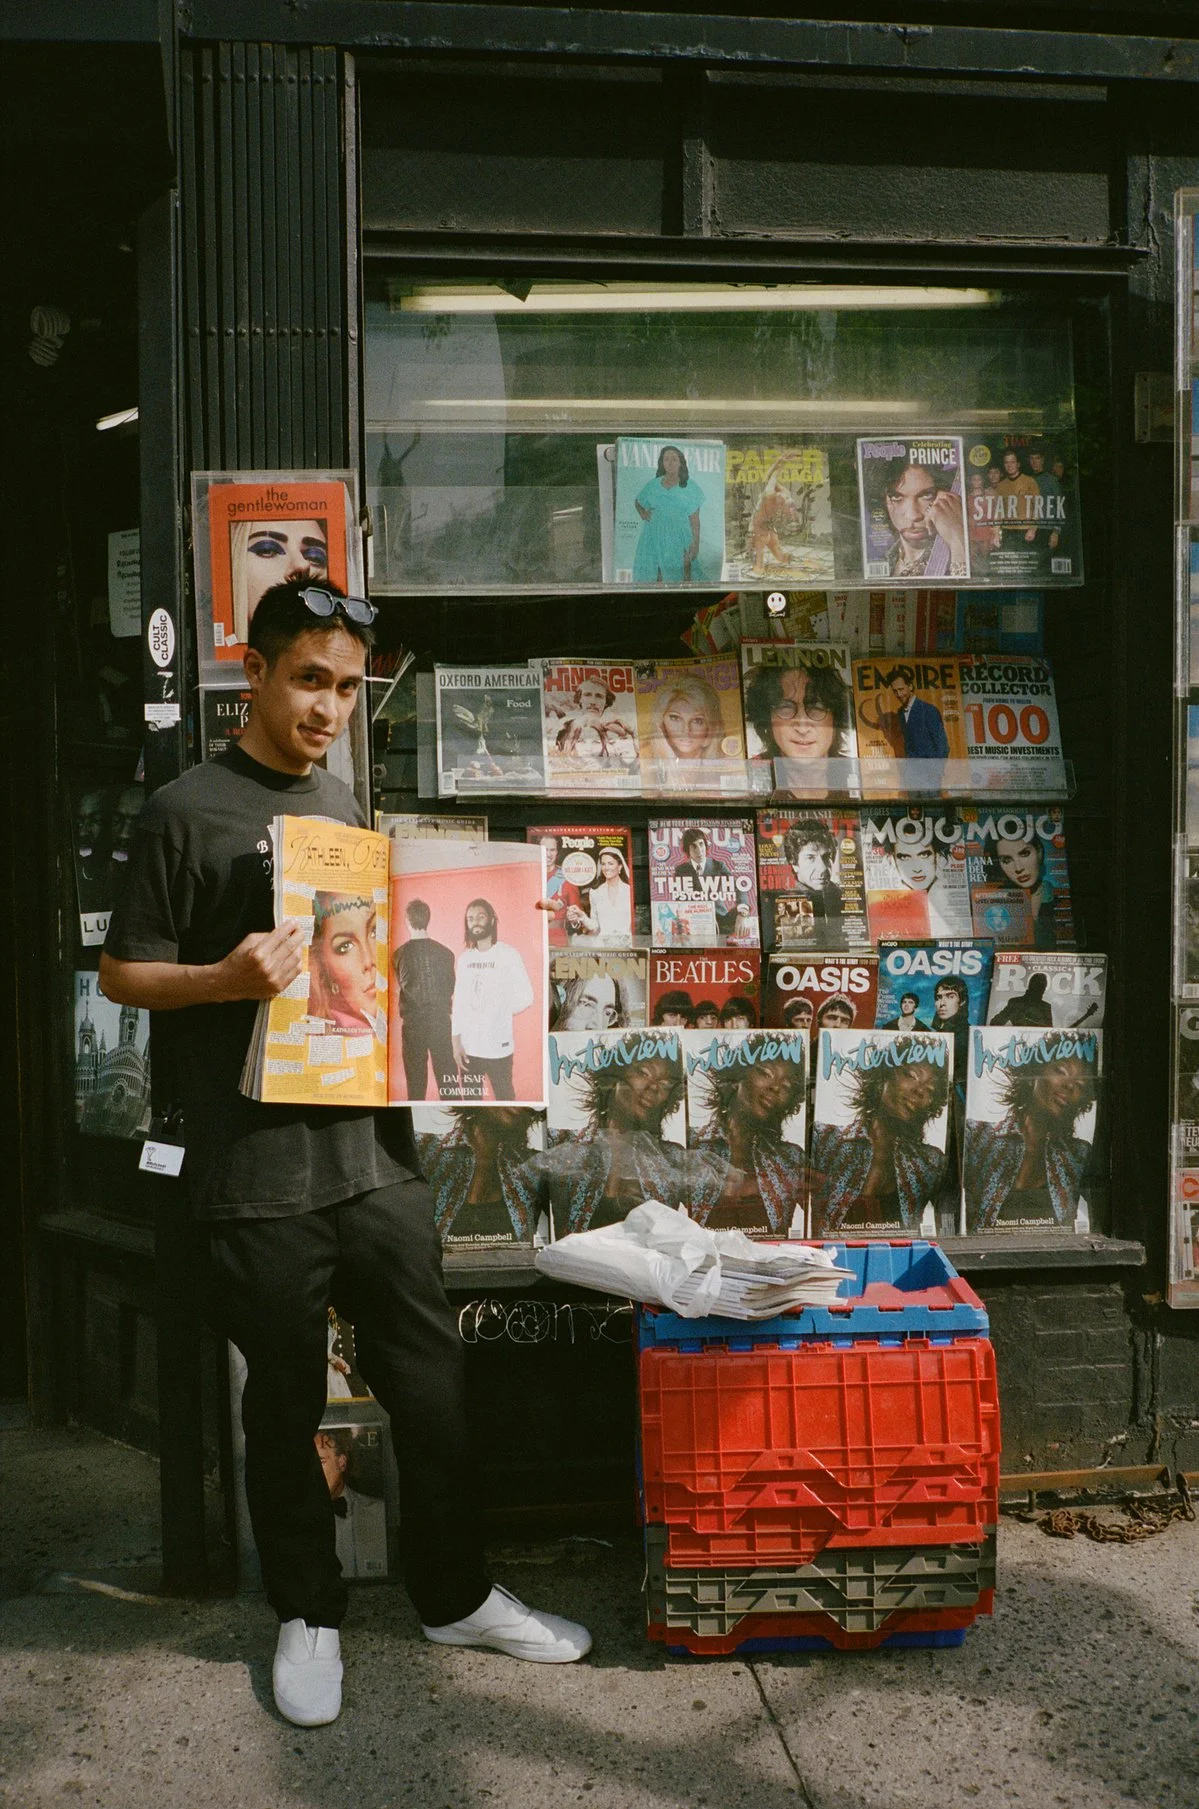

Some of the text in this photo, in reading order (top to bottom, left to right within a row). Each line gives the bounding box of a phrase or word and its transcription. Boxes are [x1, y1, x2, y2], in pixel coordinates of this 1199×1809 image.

[863, 442, 906, 461] People
[909, 448, 957, 465] PRINCE
[778, 469, 824, 483] GAGA
[266, 487, 289, 501] the
[227, 497, 329, 517] gentlewoman
[972, 494, 1066, 521] STAR TREK
[153, 625, 161, 651] CULT
[160, 615, 169, 660] CLASSIC
[746, 647, 847, 669] LENNON
[439, 673, 541, 687] OXFORD AMERICAN
[959, 664, 1050, 683] RECORD
[960, 682, 1052, 696] COLLECTOR
[506, 699, 531, 708] Food
[964, 703, 1050, 745] 100
[967, 746, 1060, 755] BEST MUSIC INVESTMENTS
[779, 809, 832, 819] THE CLASH
[862, 816, 963, 848] MOJO
[966, 814, 1064, 844] MOJO
[561, 836, 595, 850] People
[968, 856, 993, 866] LANA
[969, 865, 986, 874] DEL
[654, 876, 753, 894] THE WHO
[969, 873, 988, 882] REY
[672, 891, 708, 901] PSYCH
[886, 949, 982, 976] OASIS
[996, 955, 1020, 963] FREE
[554, 957, 646, 980] ENNON
[656, 960, 754, 983] BEATLES
[776, 965, 870, 993] OASIS
[996, 964, 1104, 996] ROCK
[549, 1031, 679, 1085] Interview
[822, 1030, 946, 1081] Interview
[973, 1028, 1098, 1080] Interview
[439, 1087, 489, 1096] COMMERCIAL
[841, 1221, 900, 1231] Naomi Campbell
[995, 1217, 1054, 1227] Naomi Campbell
[447, 1233, 512, 1243] Naomi Campbell
